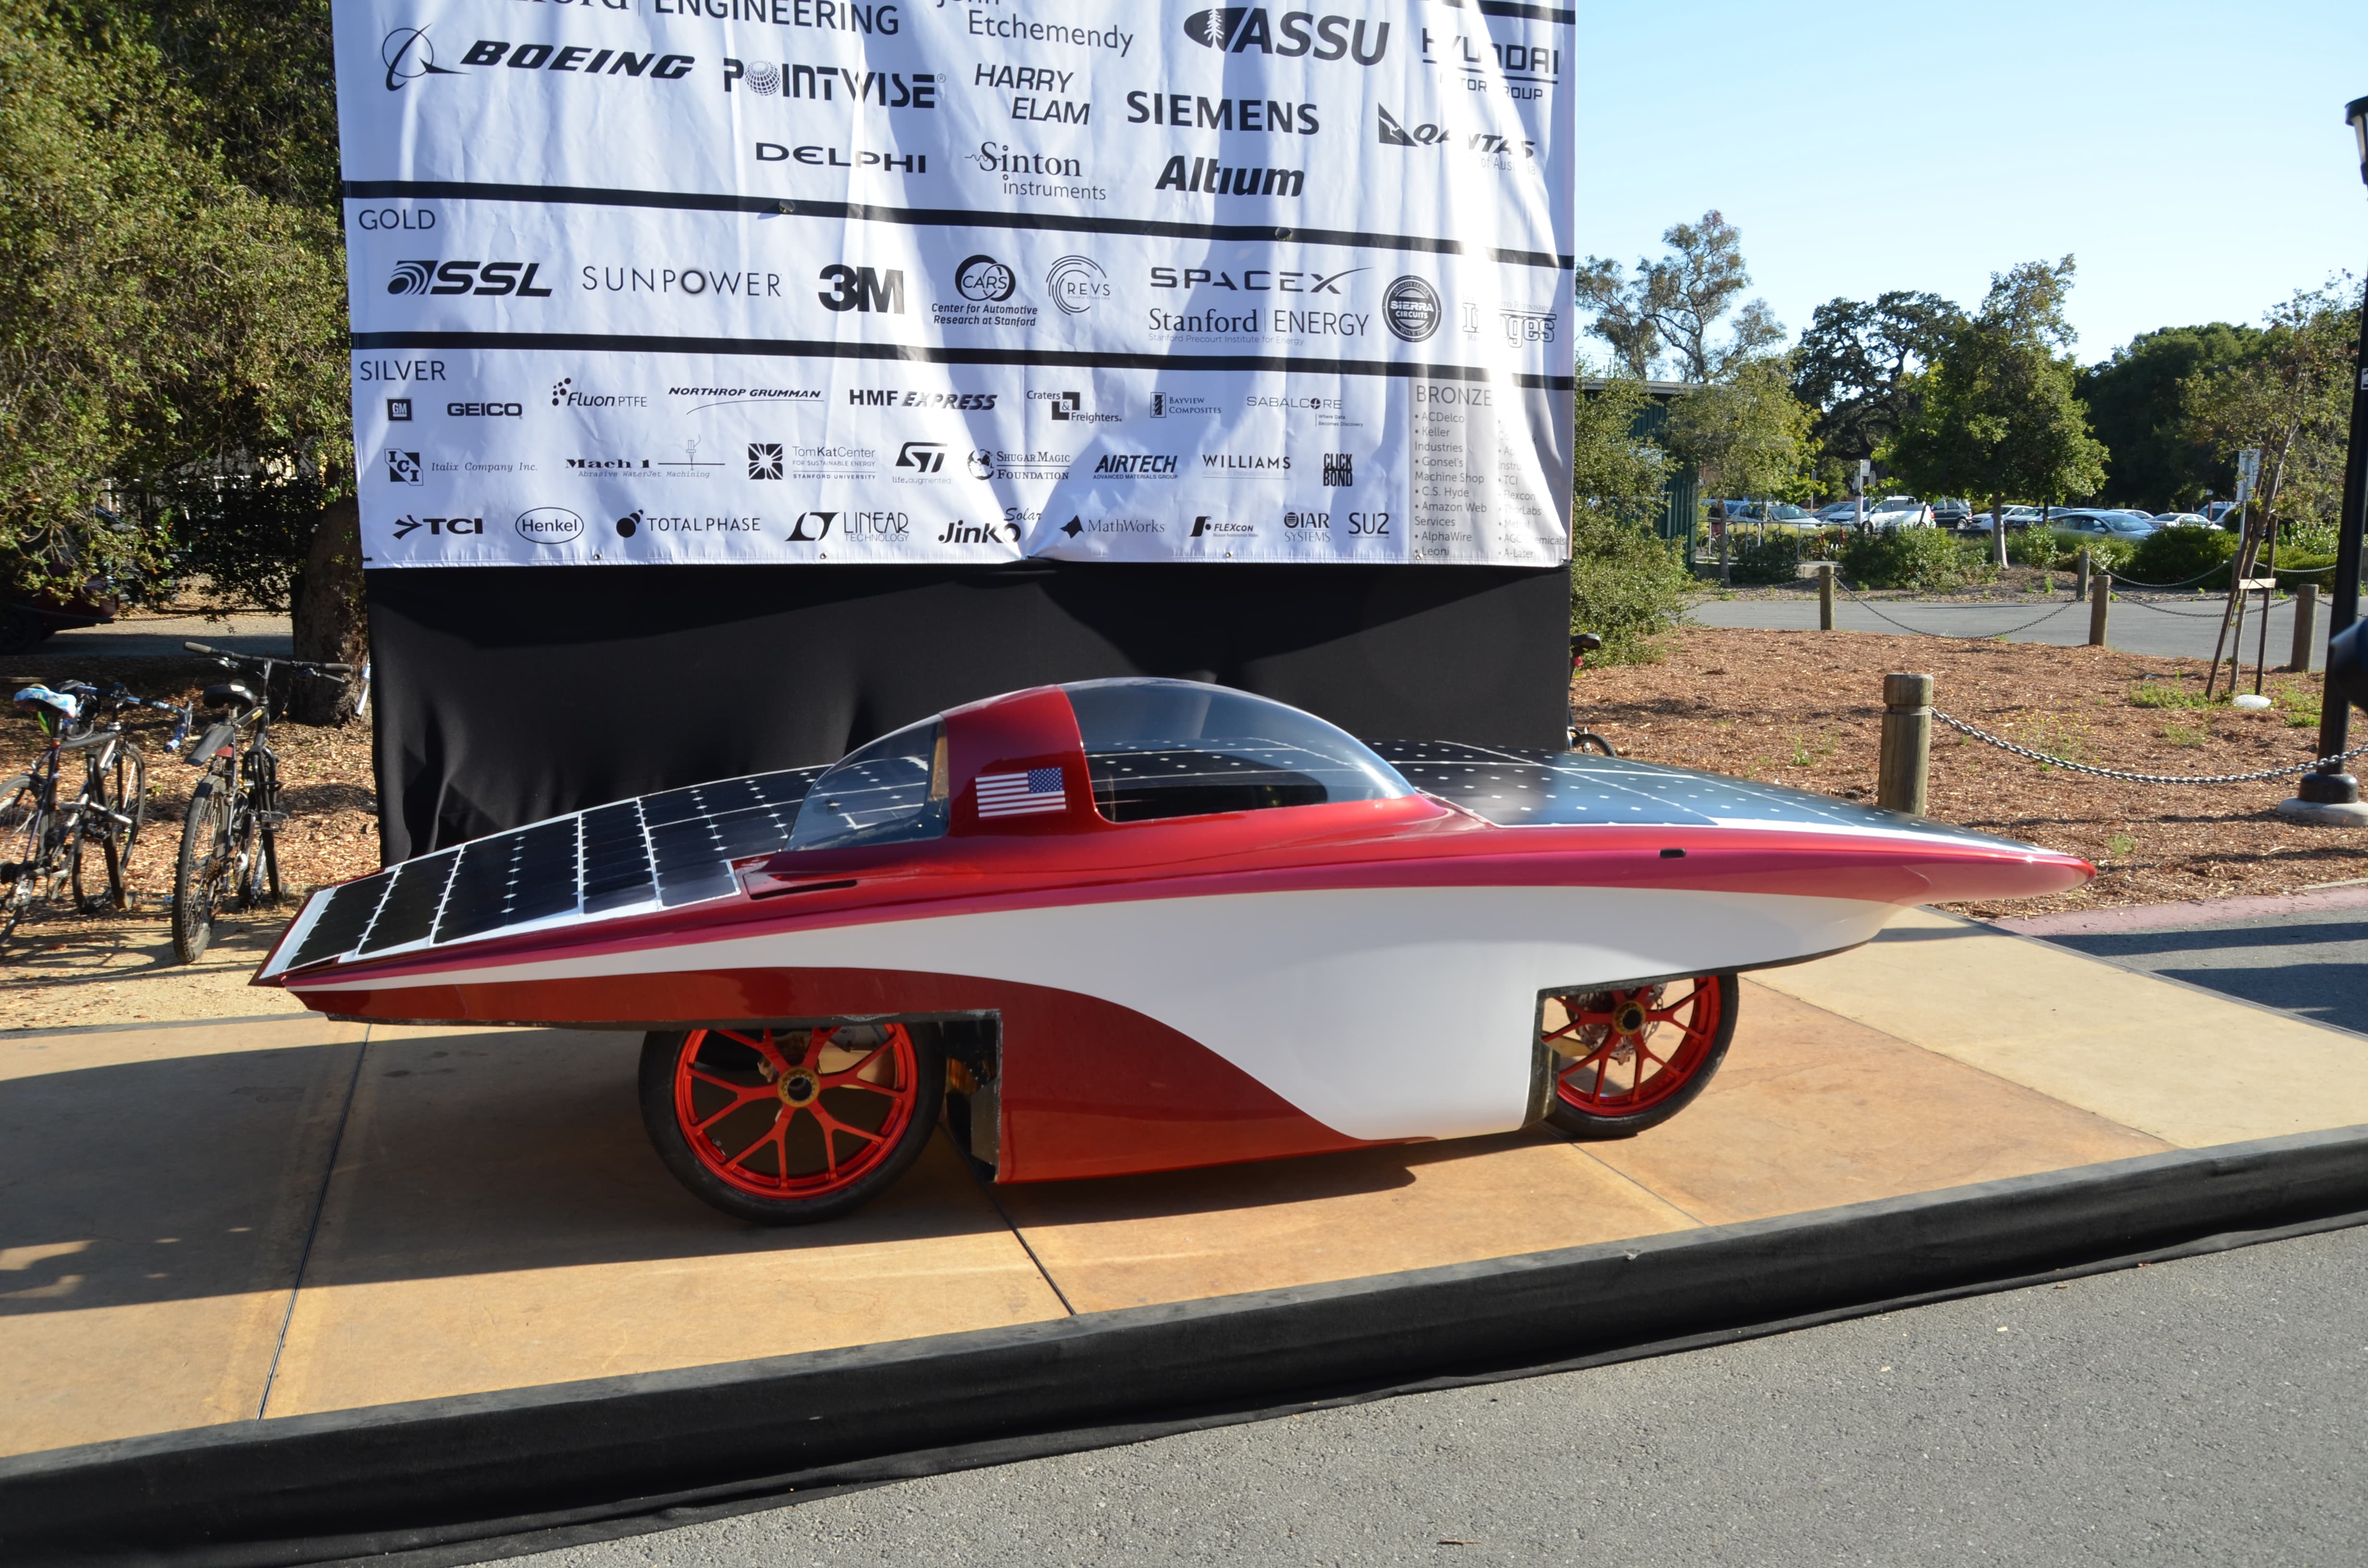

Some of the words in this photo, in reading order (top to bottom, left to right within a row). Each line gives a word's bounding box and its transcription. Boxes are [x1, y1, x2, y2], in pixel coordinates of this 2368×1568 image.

[969, 10, 1133, 57] Etchemendy
[1231, 8, 1390, 66] ASSU
[460, 40, 695, 79] BOEING
[724, 58, 935, 108] POINTWISE
[974, 63, 1074, 93] HARRY
[1011, 97, 1090, 125] ELAM
[1127, 91, 1320, 135] SIEMENS
[756, 142, 925, 173] DELPHI
[979, 142, 1083, 177] Sinton
[1155, 156, 1304, 196] Altium
[1003, 174, 1106, 200] instruments
[358, 209, 435, 230] GOLD
[430, 261, 553, 297] SSL
[582, 266, 781, 297] SUNPOWER
[963, 275, 1007, 289] CARS
[1150, 267, 1376, 294] SPACEX
[818, 264, 905, 315] 3M
[1068, 282, 1110, 296] REVS
[932, 303, 964, 312] Center
[966, 304, 980, 314] for
[983, 305, 1037, 315] Automotive
[934, 315, 979, 325] Research
[995, 316, 1036, 327] Stanford
[1148, 308, 1258, 332] Stanford
[1274, 310, 1369, 336] ENERGY
[1225, 335, 1260, 343] Institute
[1276, 336, 1304, 346] Energy
[360, 361, 446, 380] SILVER
[567, 392, 615, 406] Fluon
[618, 396, 647, 407] PTFE
[668, 387, 746, 396] NORTHROP
[750, 389, 821, 398] GRUMMAN
[850, 390, 898, 406] HMF
[901, 392, 998, 410] EXPRESS
[1027, 391, 1060, 400] Craters
[1417, 385, 1492, 406] BRONZE
[392, 403, 407, 414] GM
[447, 403, 522, 416] GEICO
[1061, 402, 1070, 411] &
[1247, 396, 1342, 409] SABALCORE
[1422, 412, 1465, 423] ACDelco
[1422, 427, 1450, 437] Keller
[1415, 441, 1463, 453] Industries
[432, 462, 458, 471] Italix
[465, 462, 513, 473] Company
[519, 462, 537, 471] Inc.
[565, 459, 632, 469] Mach
[640, 459, 650, 469] 1
[1095, 455, 1177, 473] AIRTECH
[1202, 454, 1291, 469] WILLIAMS
[1323, 453, 1352, 470] CLICK
[1422, 457, 1464, 467] Gonsel's
[1323, 469, 1352, 486] BOND
[1415, 471, 1457, 482] Machine
[1460, 473, 1484, 485] Shop
[1504, 475, 1518, 485] TCI
[1422, 486, 1441, 496] C.S.
[1444, 487, 1469, 499] Hyde
[1004, 507, 1041, 522] Solar
[1422, 502, 1463, 512] Amazon
[1466, 502, 1487, 513] Web
[423, 518, 483, 534] TCI
[522, 519, 577, 531] Henkel
[844, 512, 909, 533] LINEAR
[1088, 519, 1165, 533] MathWorks
[1300, 513, 1330, 528] IAR
[1348, 512, 1390, 534] SU2
[1415, 516, 1455, 527] Services
[844, 533, 909, 542] TECHNOLOGY
[1284, 531, 1330, 542] SYSTEMS
[1421, 531, 1472, 543] AlphaWire
[1421, 546, 1450, 556] Leoni
